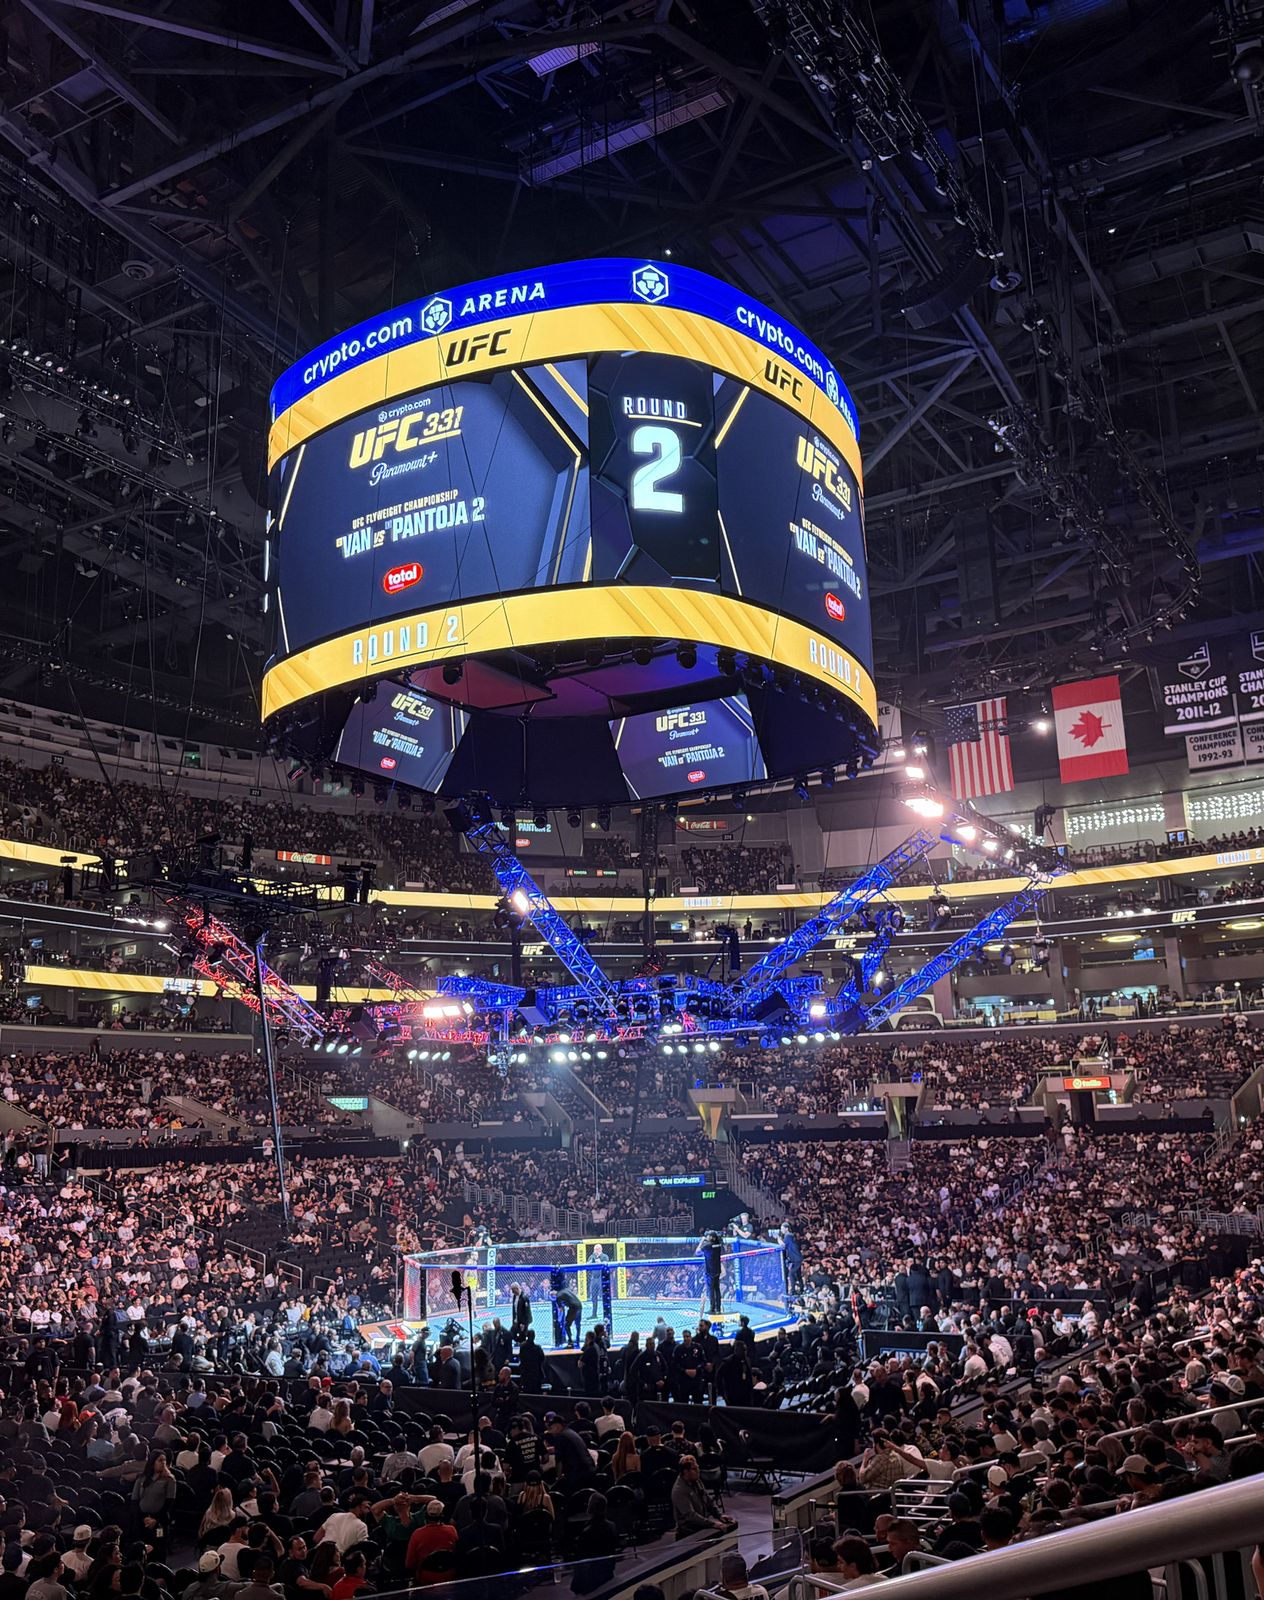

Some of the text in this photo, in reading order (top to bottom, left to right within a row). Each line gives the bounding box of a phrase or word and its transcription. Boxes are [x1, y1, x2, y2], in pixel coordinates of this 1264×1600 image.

[304, 282, 546, 385] crypto.com ARENA
[736, 306, 824, 383] crypto.com
[445, 329, 512, 367] UFC
[764, 359, 804, 402] UFC
[388, 397, 431, 418] crypto.com
[624, 396, 686, 419] ROUND
[349, 406, 464, 469] UFC 331
[371, 451, 438, 486] Paramount+
[632, 426, 684, 513] 2
[797, 435, 851, 505] UFC 331
[352, 518, 365, 530] UFC
[366, 504, 402, 525] FLYWEIGHT
[404, 489, 459, 513] CHAMPIONSHIP
[342, 496, 485, 559] VAN VS PANTOJA 2
[795, 526, 817, 560] VAN
[827, 548, 857, 595] PANTOJA
[855, 576, 862, 600] 2
[388, 565, 417, 585] total
[353, 615, 460, 666] ROUND 2
[809, 637, 862, 694] ROUND 2
[1239, 669, 1264, 683] STAN
[1164, 675, 1227, 696] STANLEY CUP
[1165, 685, 1229, 706] CHAMPIONS
[1240, 683, 1264, 694] CHA
[391, 693, 434, 718] UFC 331
[1176, 702, 1222, 721] 2011-12
[656, 711, 706, 732] UFC 331
[373, 731, 388, 745] VAN
[391, 737, 418, 757] PANTOJA
[416, 746, 424, 758] 2
[1189, 730, 1237, 744] CONFERENCE
[1192, 738, 1236, 752] CHAMPIONS
[662, 755, 678, 767] VAN
[686, 748, 719, 763] PANTOJA
[718, 746, 725, 757] 2
[1198, 749, 1233, 763] 1992-93
[1171, 911, 1197, 923] UFC
[522, 945, 544, 955] UFC
[834, 939, 857, 949] UFC
